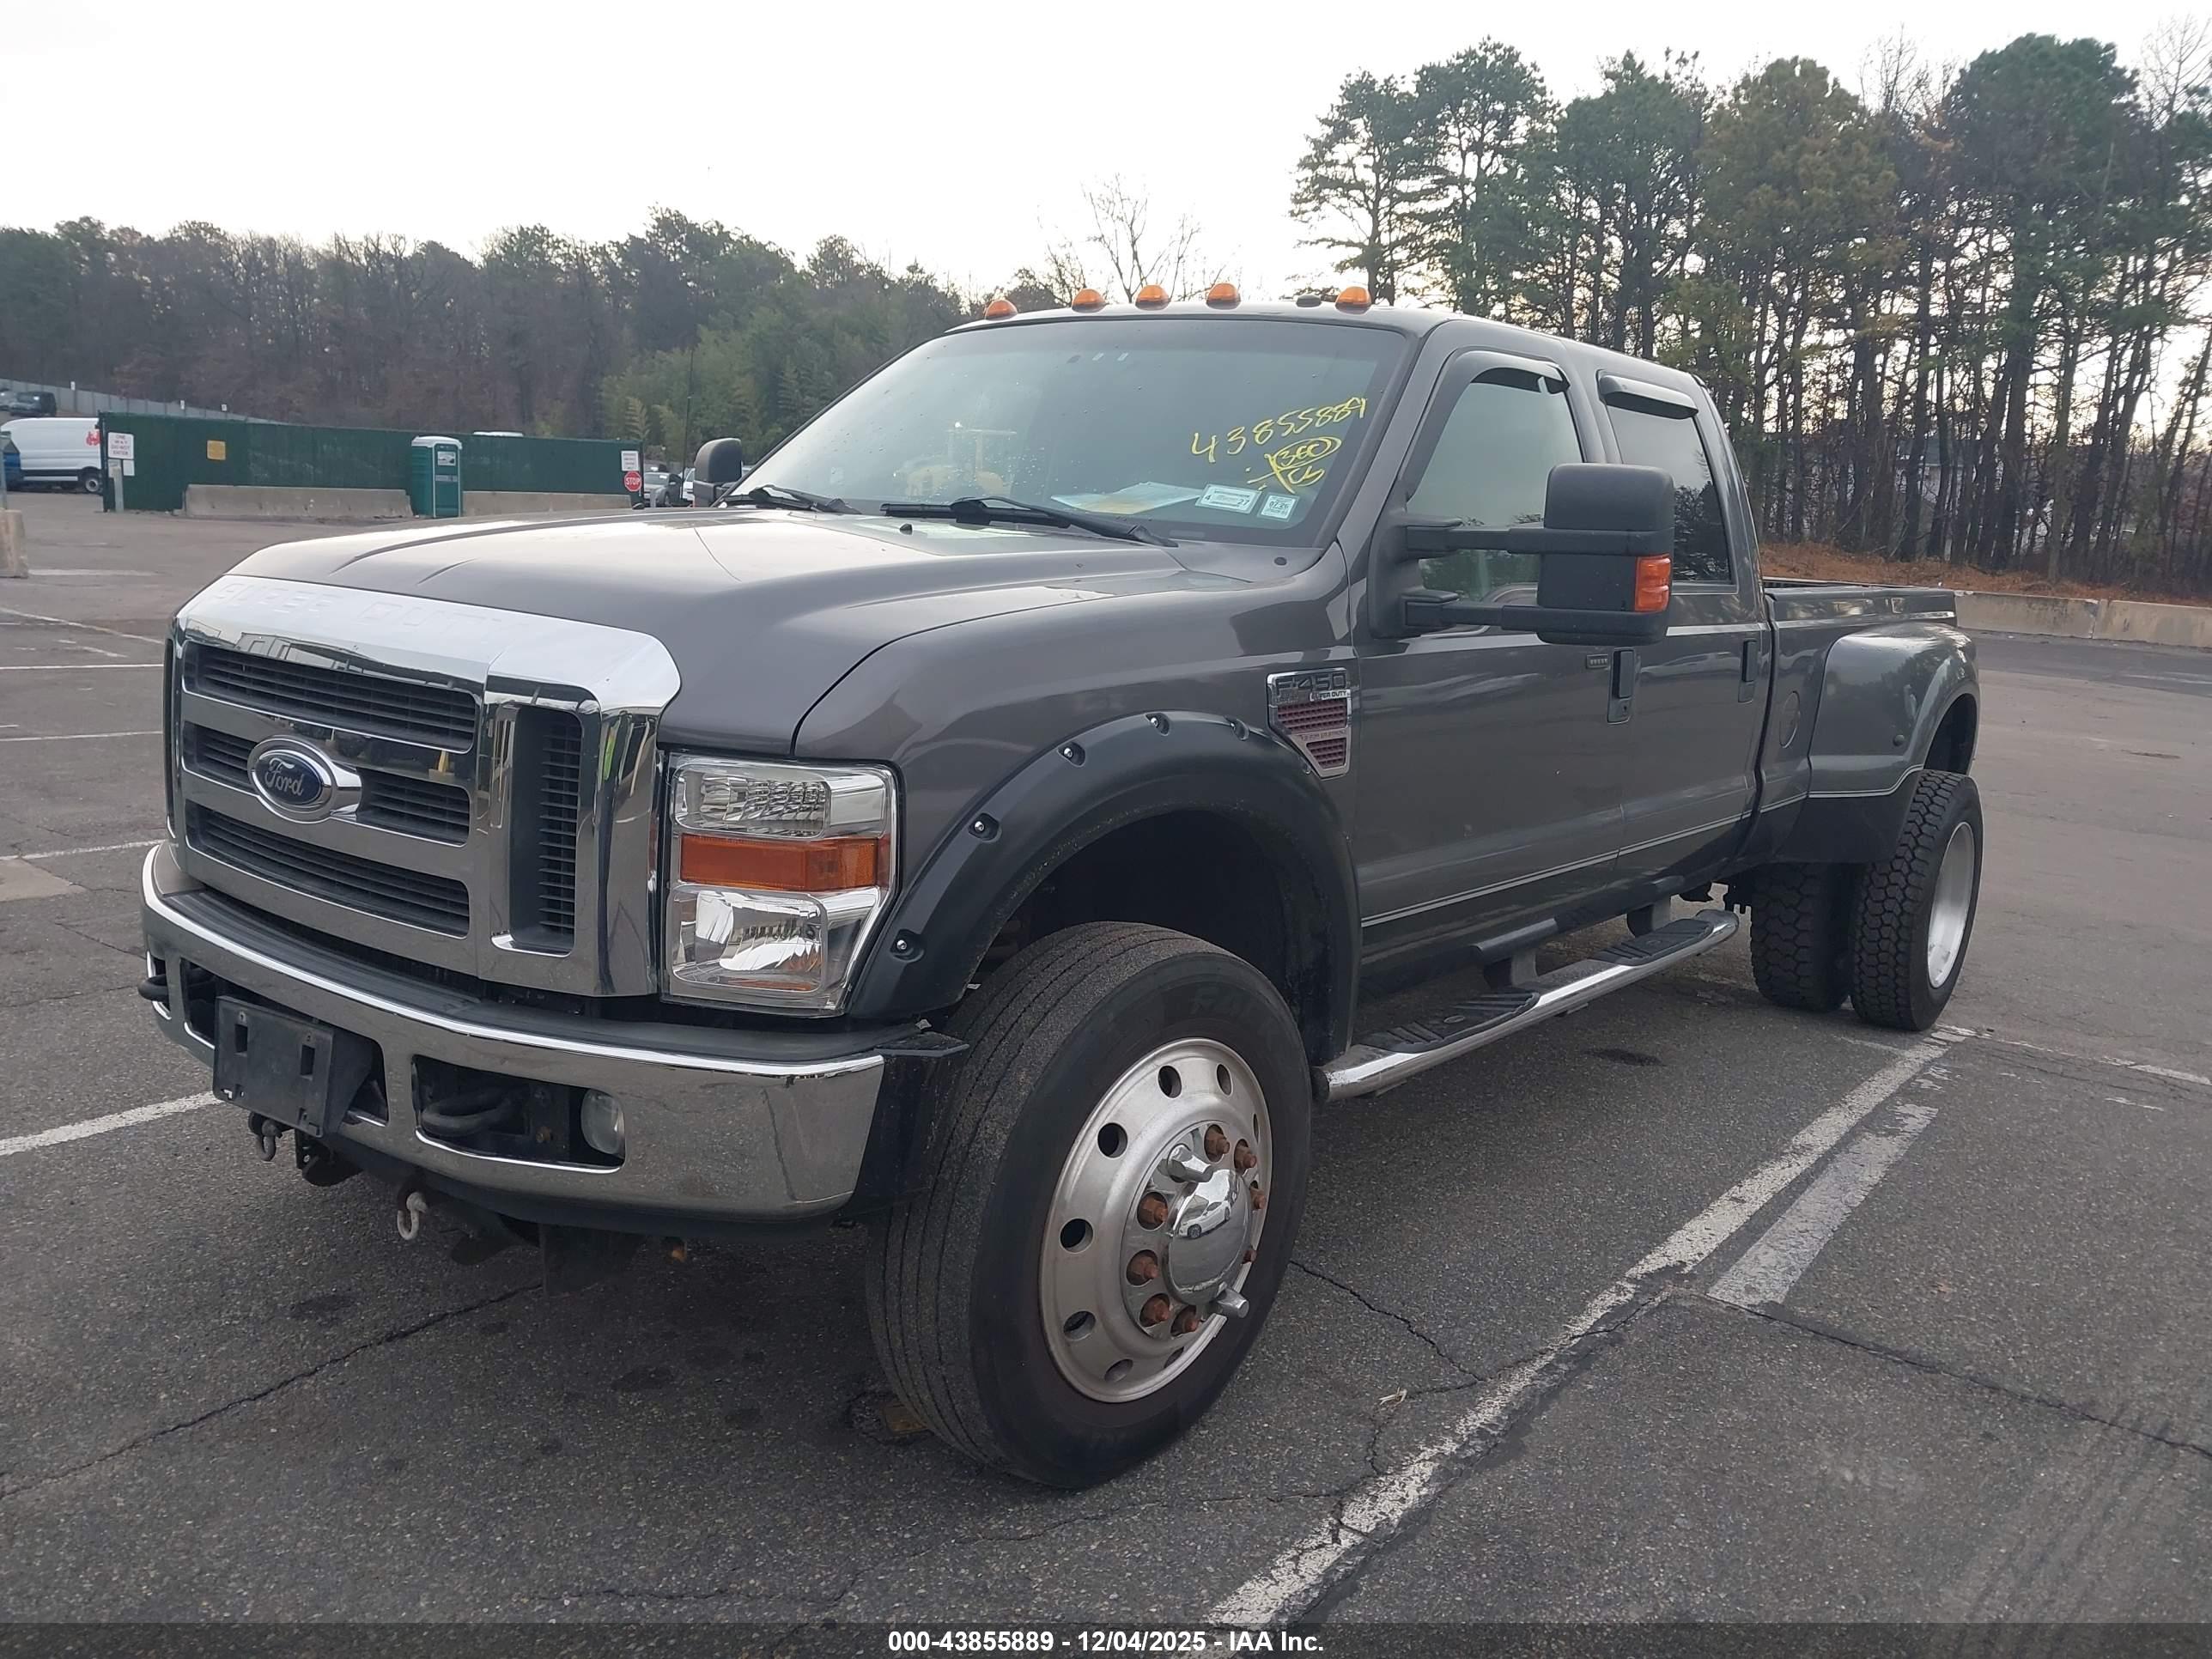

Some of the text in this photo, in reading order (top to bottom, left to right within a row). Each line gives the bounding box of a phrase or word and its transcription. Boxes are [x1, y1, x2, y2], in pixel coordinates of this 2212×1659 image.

[1191, 398, 1368, 463] 43855889
[1237, 498, 1250, 507] 27
[1332, 690, 1347, 698] DUTY
[264, 757, 305, 796] Ford
